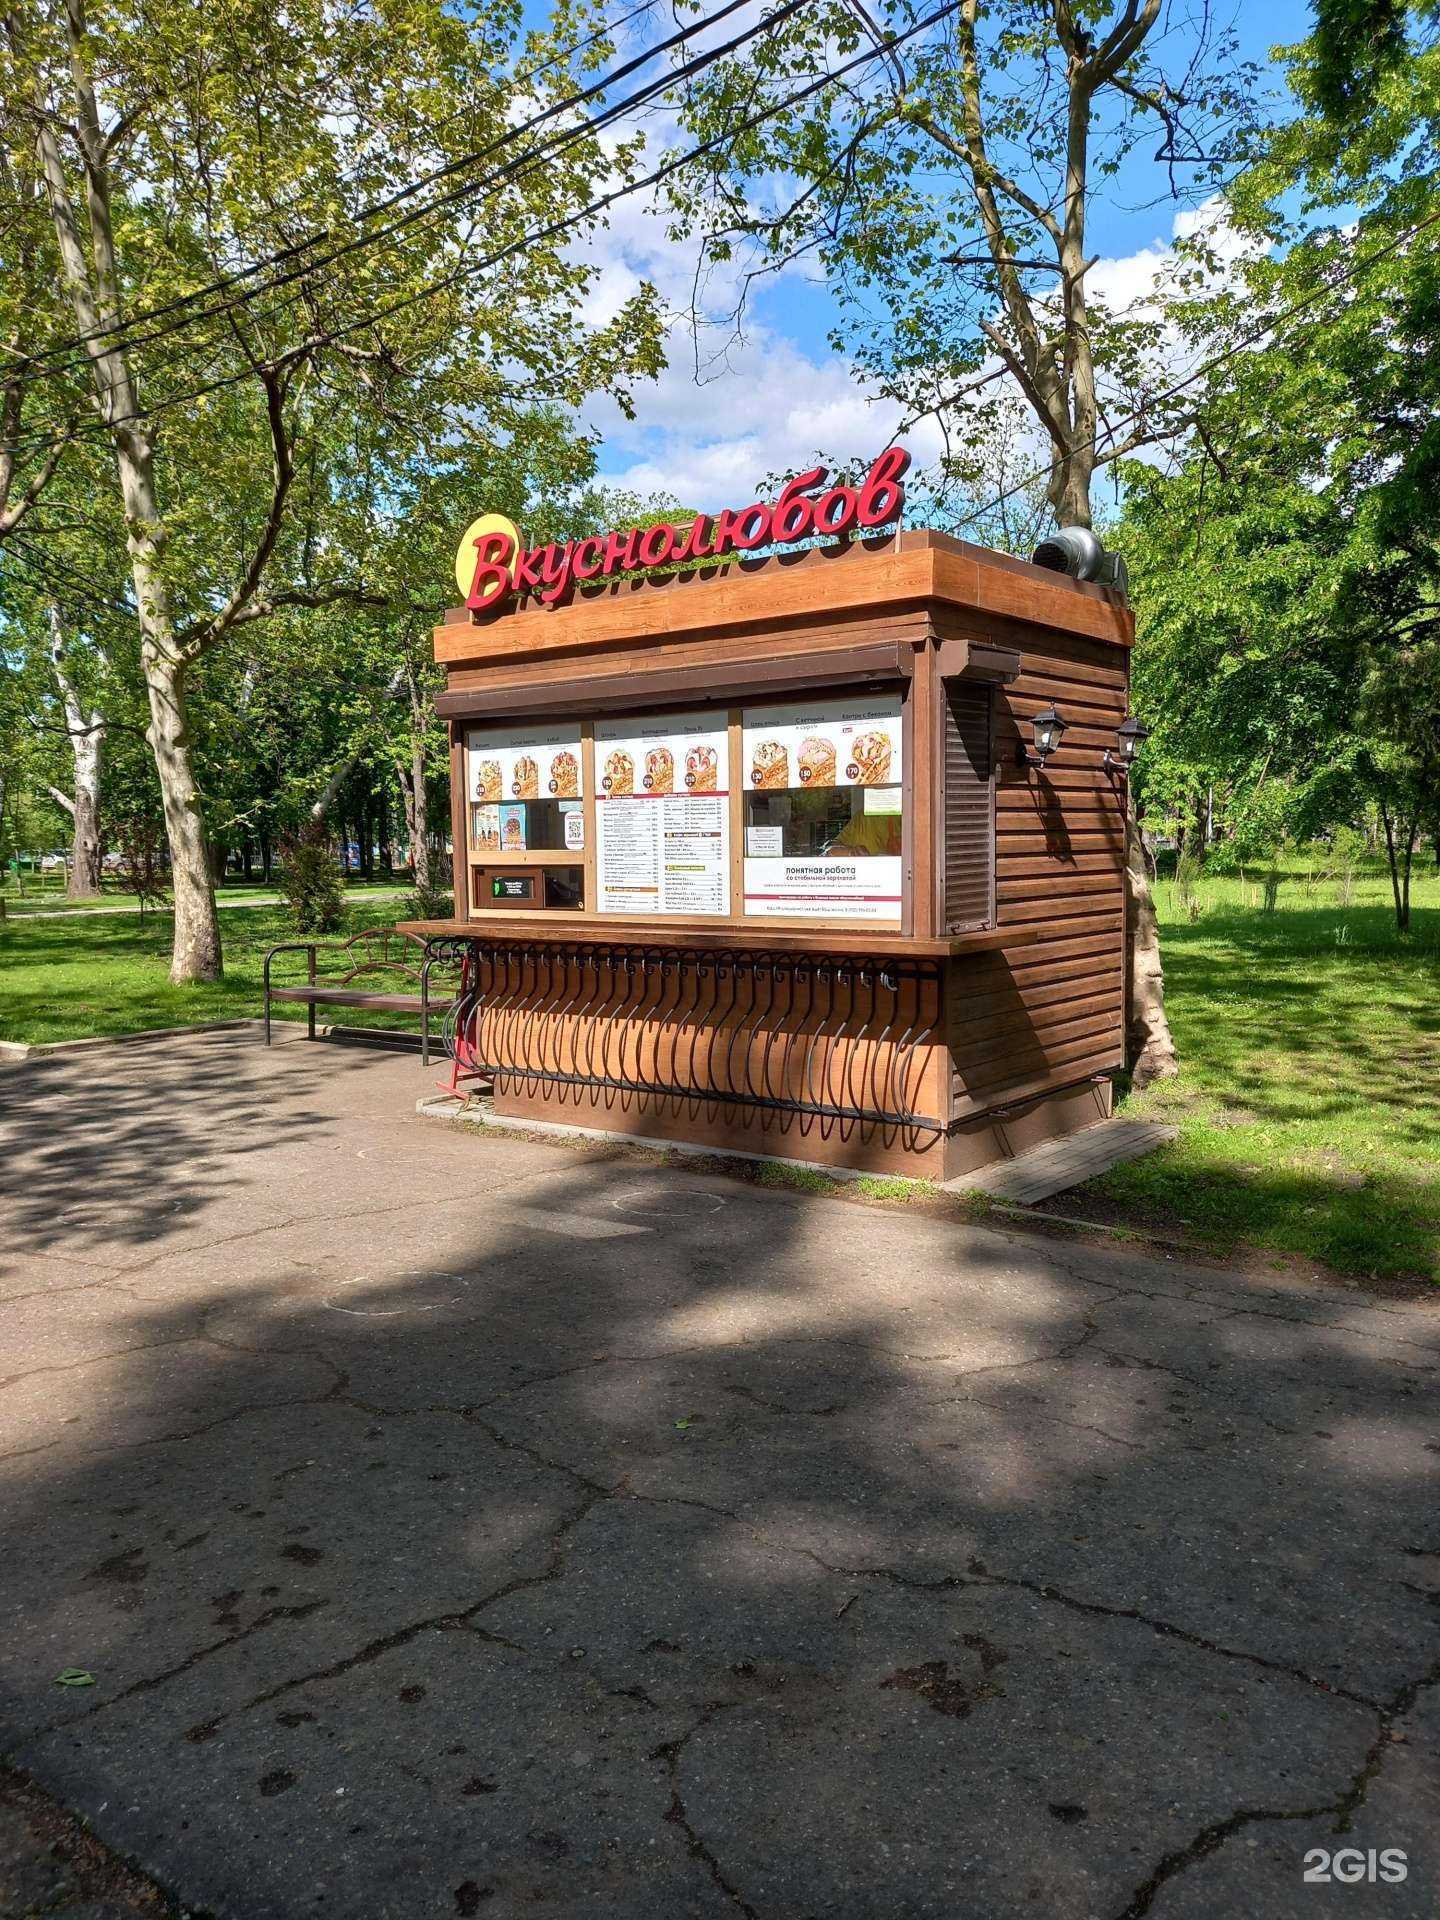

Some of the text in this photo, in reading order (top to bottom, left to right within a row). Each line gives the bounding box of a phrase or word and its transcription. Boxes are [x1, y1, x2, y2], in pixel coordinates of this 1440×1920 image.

[466, 446, 912, 613] Вкуснолюбов
[785, 865, 856, 876] понятная работа
